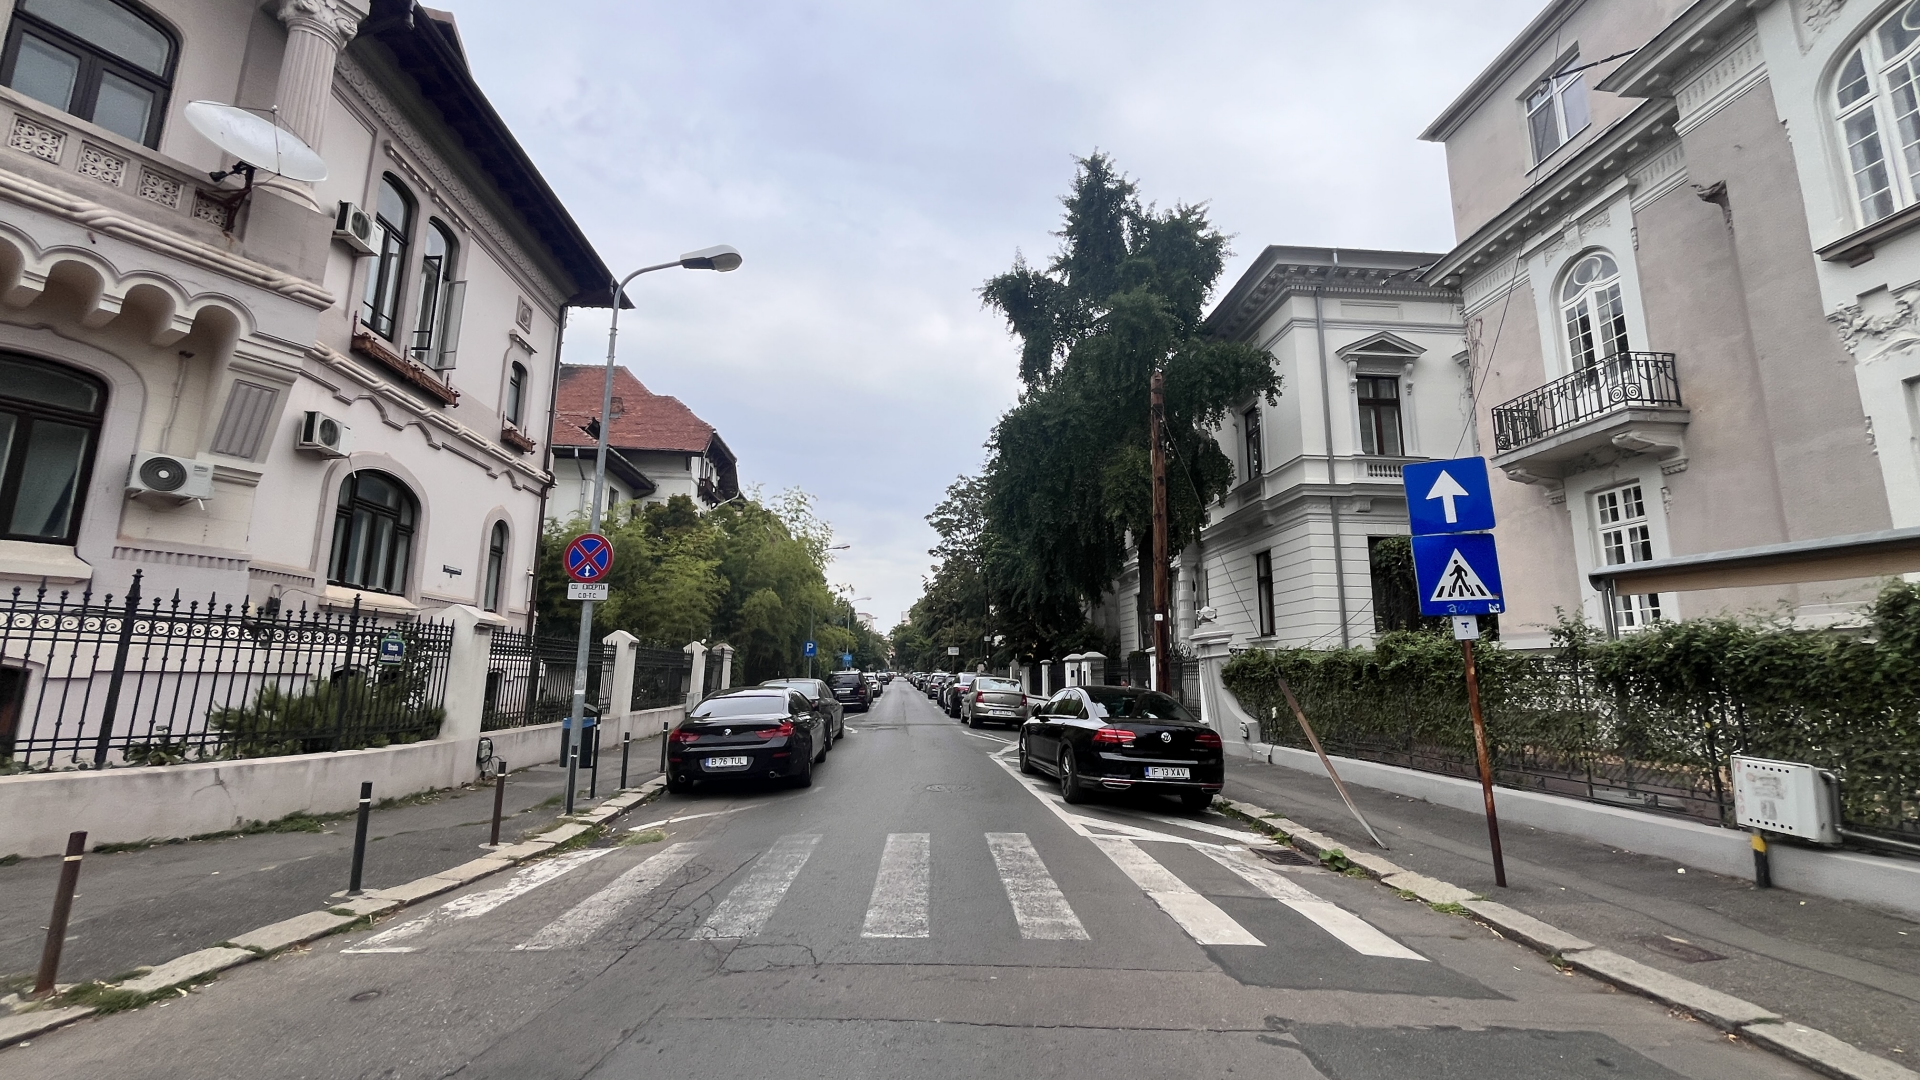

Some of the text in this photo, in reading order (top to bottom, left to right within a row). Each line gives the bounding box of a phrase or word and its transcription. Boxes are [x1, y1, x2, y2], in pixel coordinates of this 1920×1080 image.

[806, 642, 813, 652] P
[711, 757, 743, 766] B 76 TUL
[1151, 767, 1158, 776] IF
[1171, 769, 1186, 777] XAV
